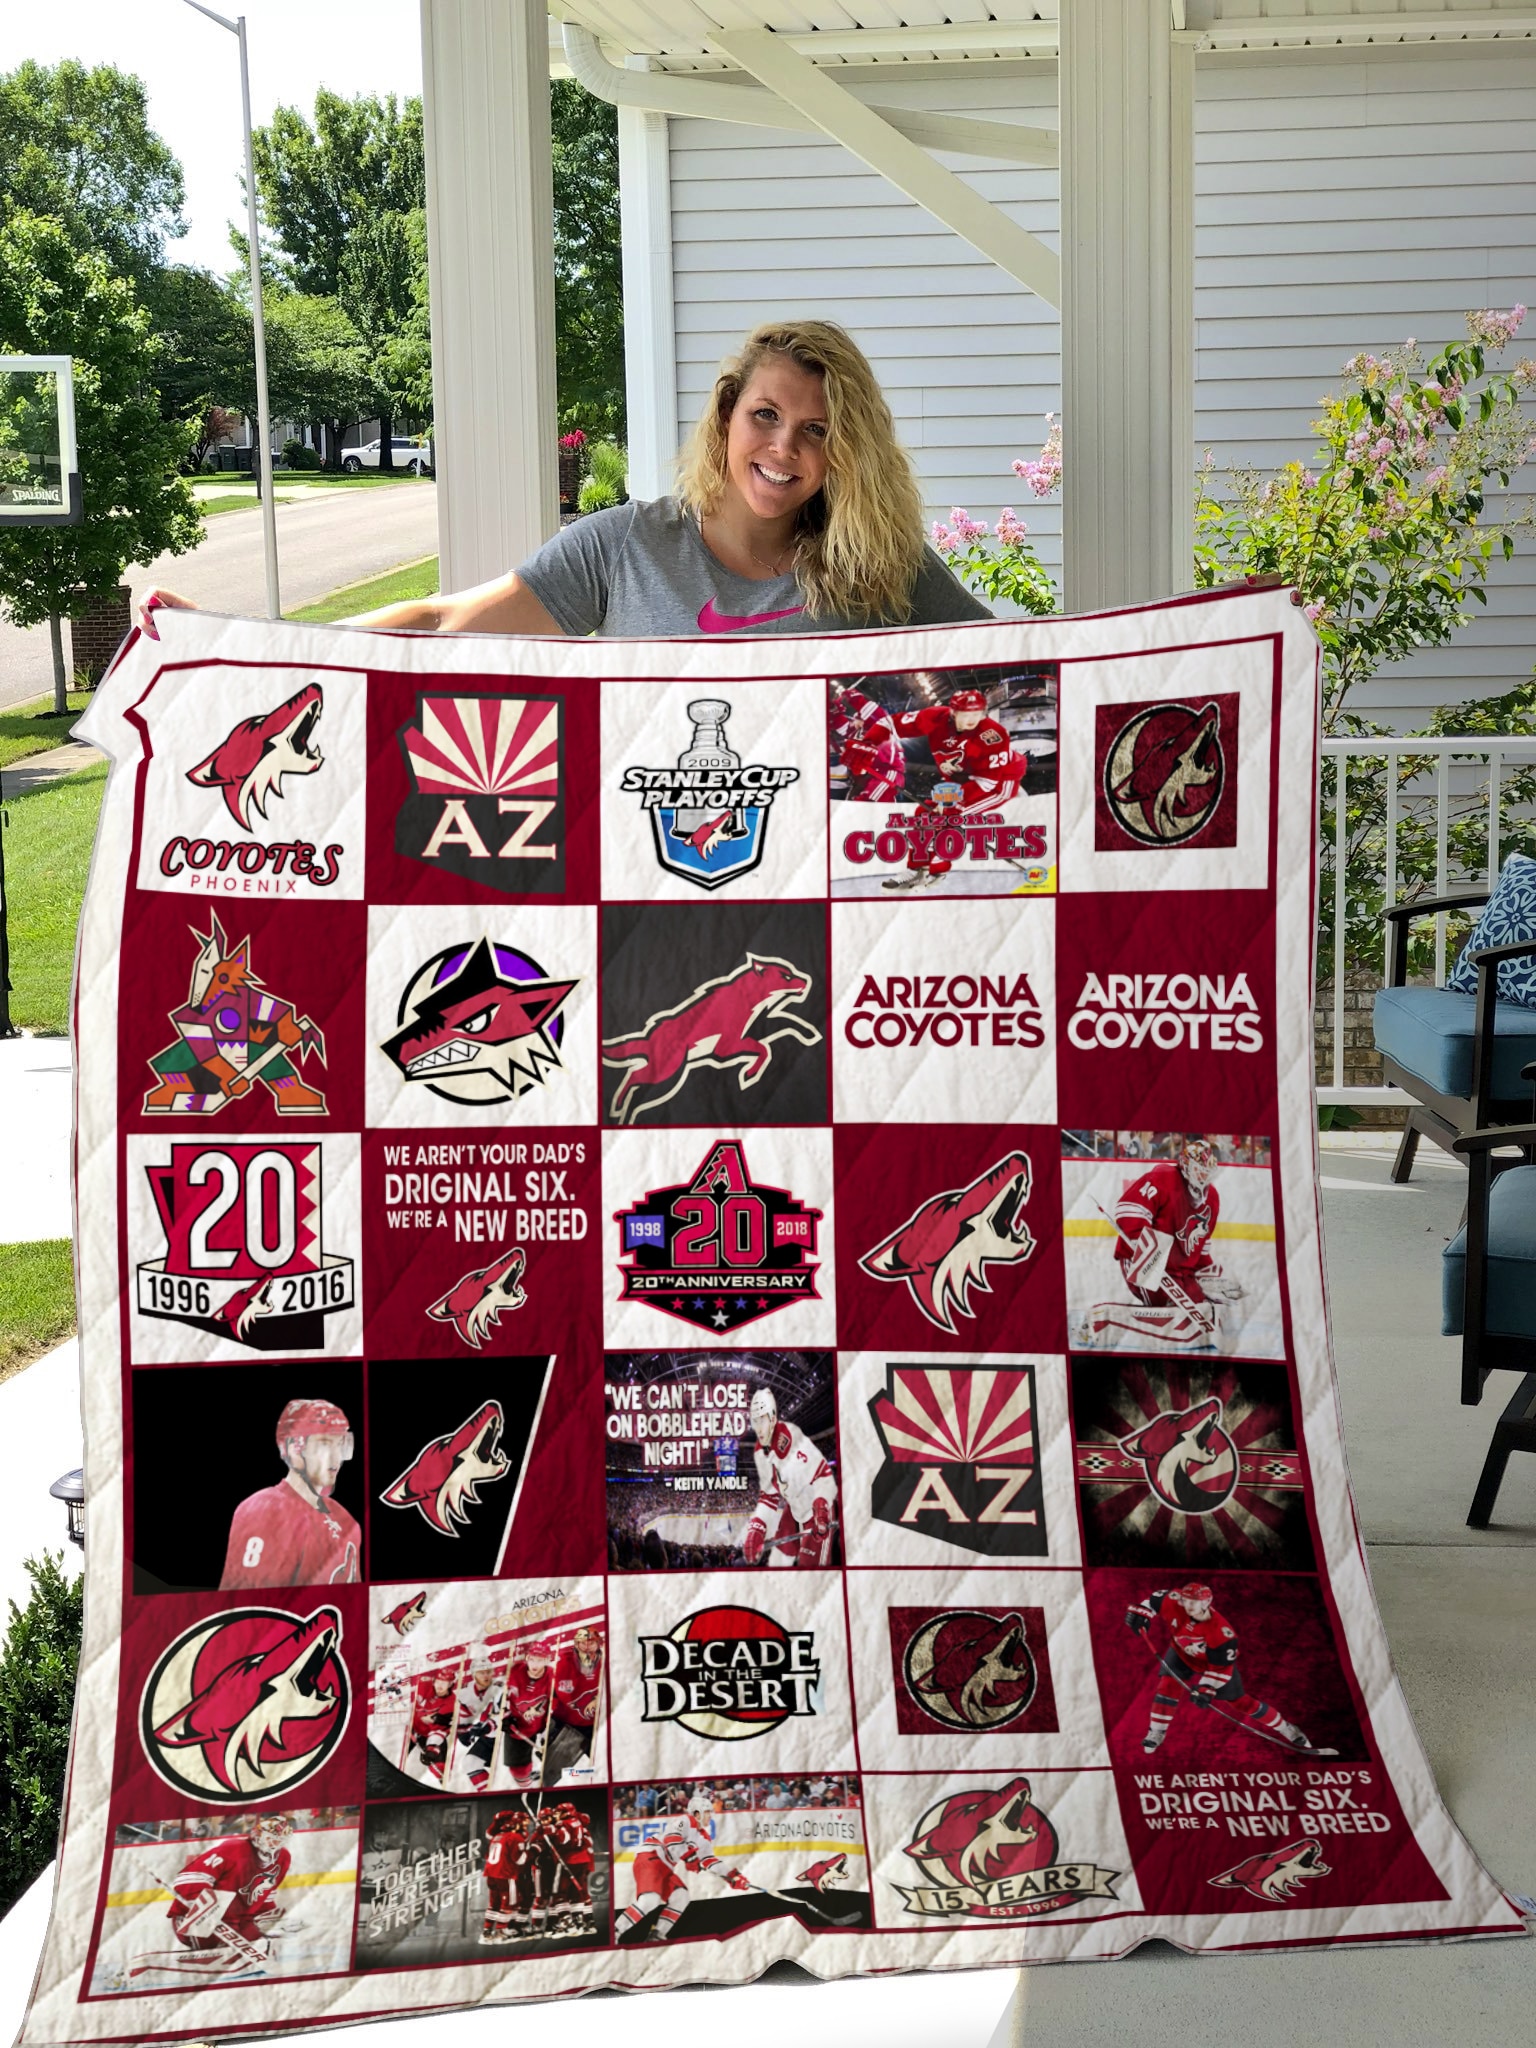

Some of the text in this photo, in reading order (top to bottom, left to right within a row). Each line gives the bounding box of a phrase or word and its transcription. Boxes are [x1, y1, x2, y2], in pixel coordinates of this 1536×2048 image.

[12, 489, 60, 502] SPALDING
[688, 758, 731, 768] 2009
[988, 751, 1008, 769] 23
[623, 766, 799, 789] STANLEY CUP
[643, 789, 774, 809] PLAYOFFS
[421, 798, 557, 860] AZ
[886, 812, 1005, 828] Arizona
[844, 825, 1048, 863] COYOTES
[160, 836, 344, 886] COYOTES
[190, 875, 297, 894] PHOENIX
[853, 973, 1039, 1009] ARIZONA
[1075, 972, 1258, 1010] ARIZONA
[844, 1010, 1046, 1049] COYOTES
[1067, 1009, 1264, 1053] COYOTES
[384, 1143, 586, 1166] WE AREN'T YOUR DAD'S
[525, 1170, 576, 1202] SIX.
[186, 1149, 296, 1270] 20
[387, 1208, 588, 1242] WE'RE A NEW BREED
[629, 1220, 808, 1237] 1998 2018
[670, 1195, 767, 1267] 20
[147, 1270, 345, 1315] 1996 2016
[675, 1274, 807, 1288] ANNIVERSARY
[1161, 1276, 1215, 1334] BAUER
[647, 1384, 699, 1410] CAN'T
[703, 1384, 747, 1409] LOSE
[606, 1412, 746, 1438] ON BOBBLEHEAD
[674, 1477, 704, 1491] KEITH
[706, 1476, 748, 1490] YANDLE
[900, 1466, 1036, 1525] AZ
[242, 1536, 265, 1567] 8
[484, 1594, 581, 1635] COYOTES
[512, 1588, 565, 1612] ARIZONA
[642, 1635, 816, 1677] DECADE
[698, 1668, 762, 1681] IN THE
[643, 1672, 818, 1719] DESERT
[1134, 1770, 1372, 1789] WE AREN'T YOUR DAD'S
[1304, 1789, 1368, 1811] SIX.
[1145, 1812, 1391, 1838] WE'RE A NEW BREED
[372, 1839, 482, 1896] TOGETHER
[371, 1881, 431, 1916] WE'RE
[932, 1867, 1081, 1909] 15 YEARS
[369, 1876, 482, 1938] STRENGTH
[990, 1900, 1060, 1916] EST. 1996
[215, 1923, 267, 1963] BAUER
